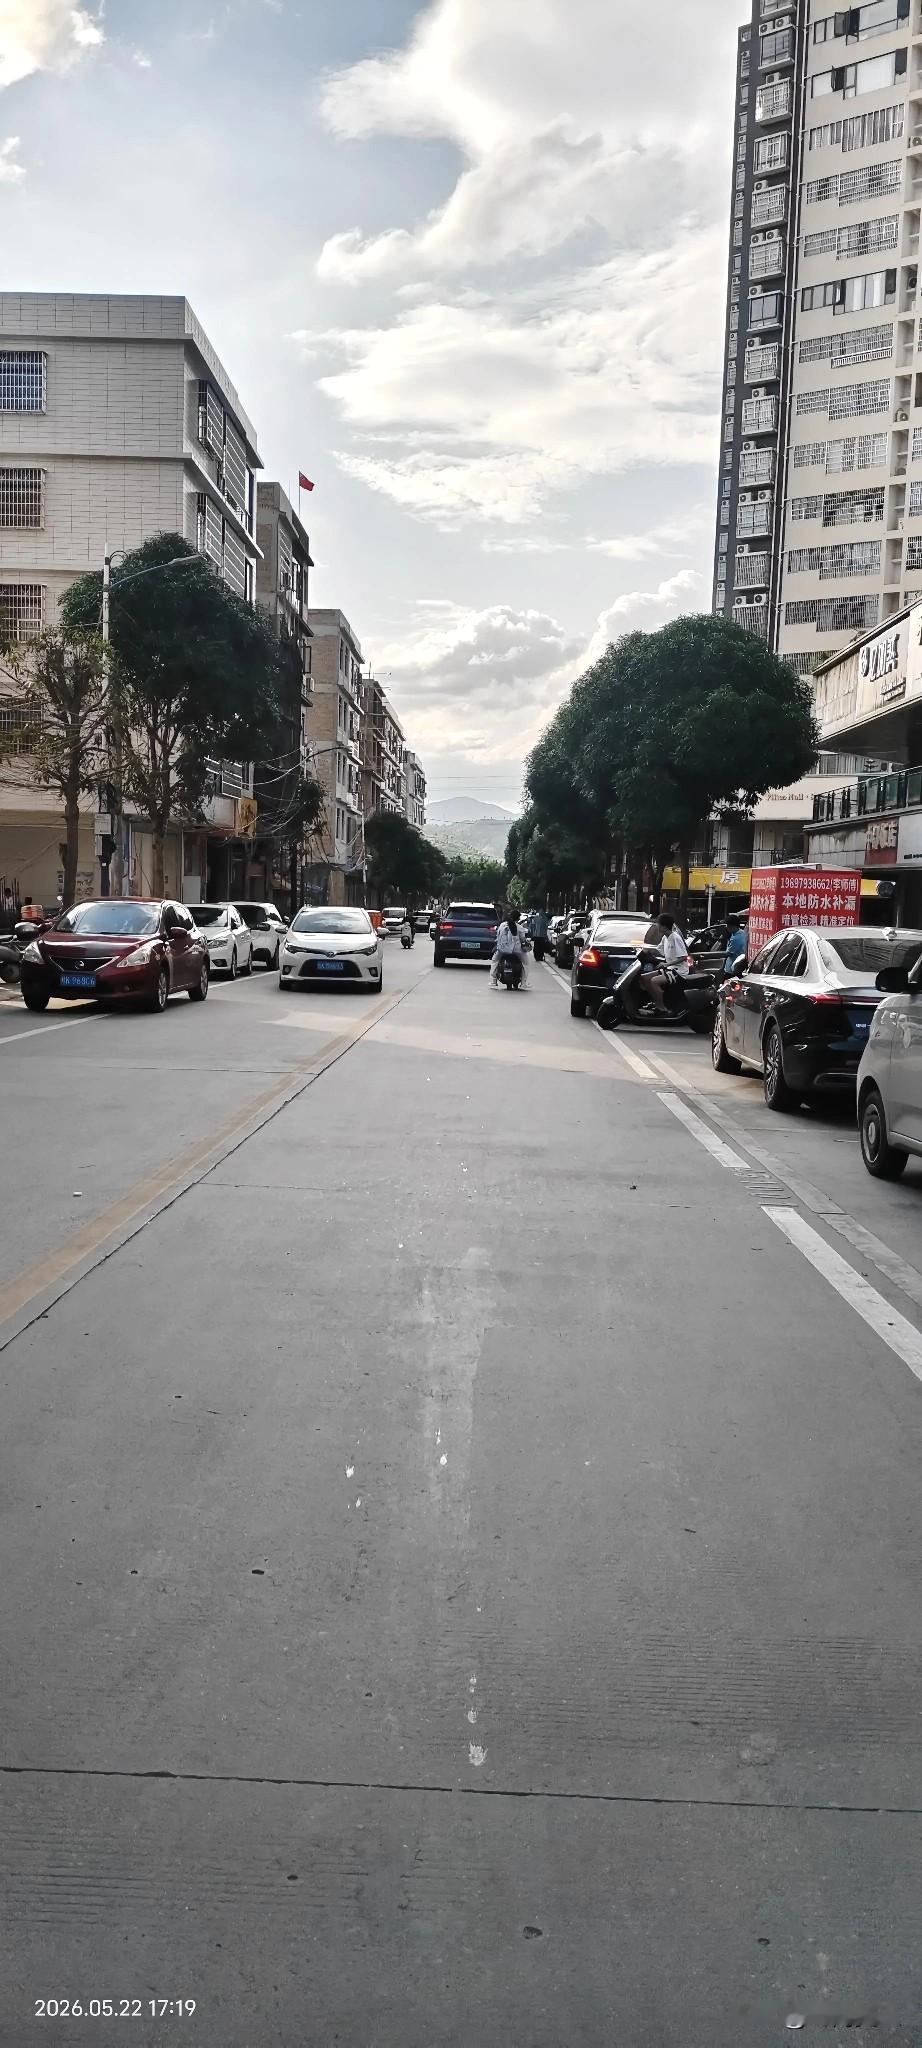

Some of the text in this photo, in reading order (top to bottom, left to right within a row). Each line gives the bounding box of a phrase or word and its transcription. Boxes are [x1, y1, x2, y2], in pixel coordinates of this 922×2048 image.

[719, 871, 740, 885] 原
[782, 893, 857, 911] 本地防水补漏
[819, 914, 855, 927] 精准定位
